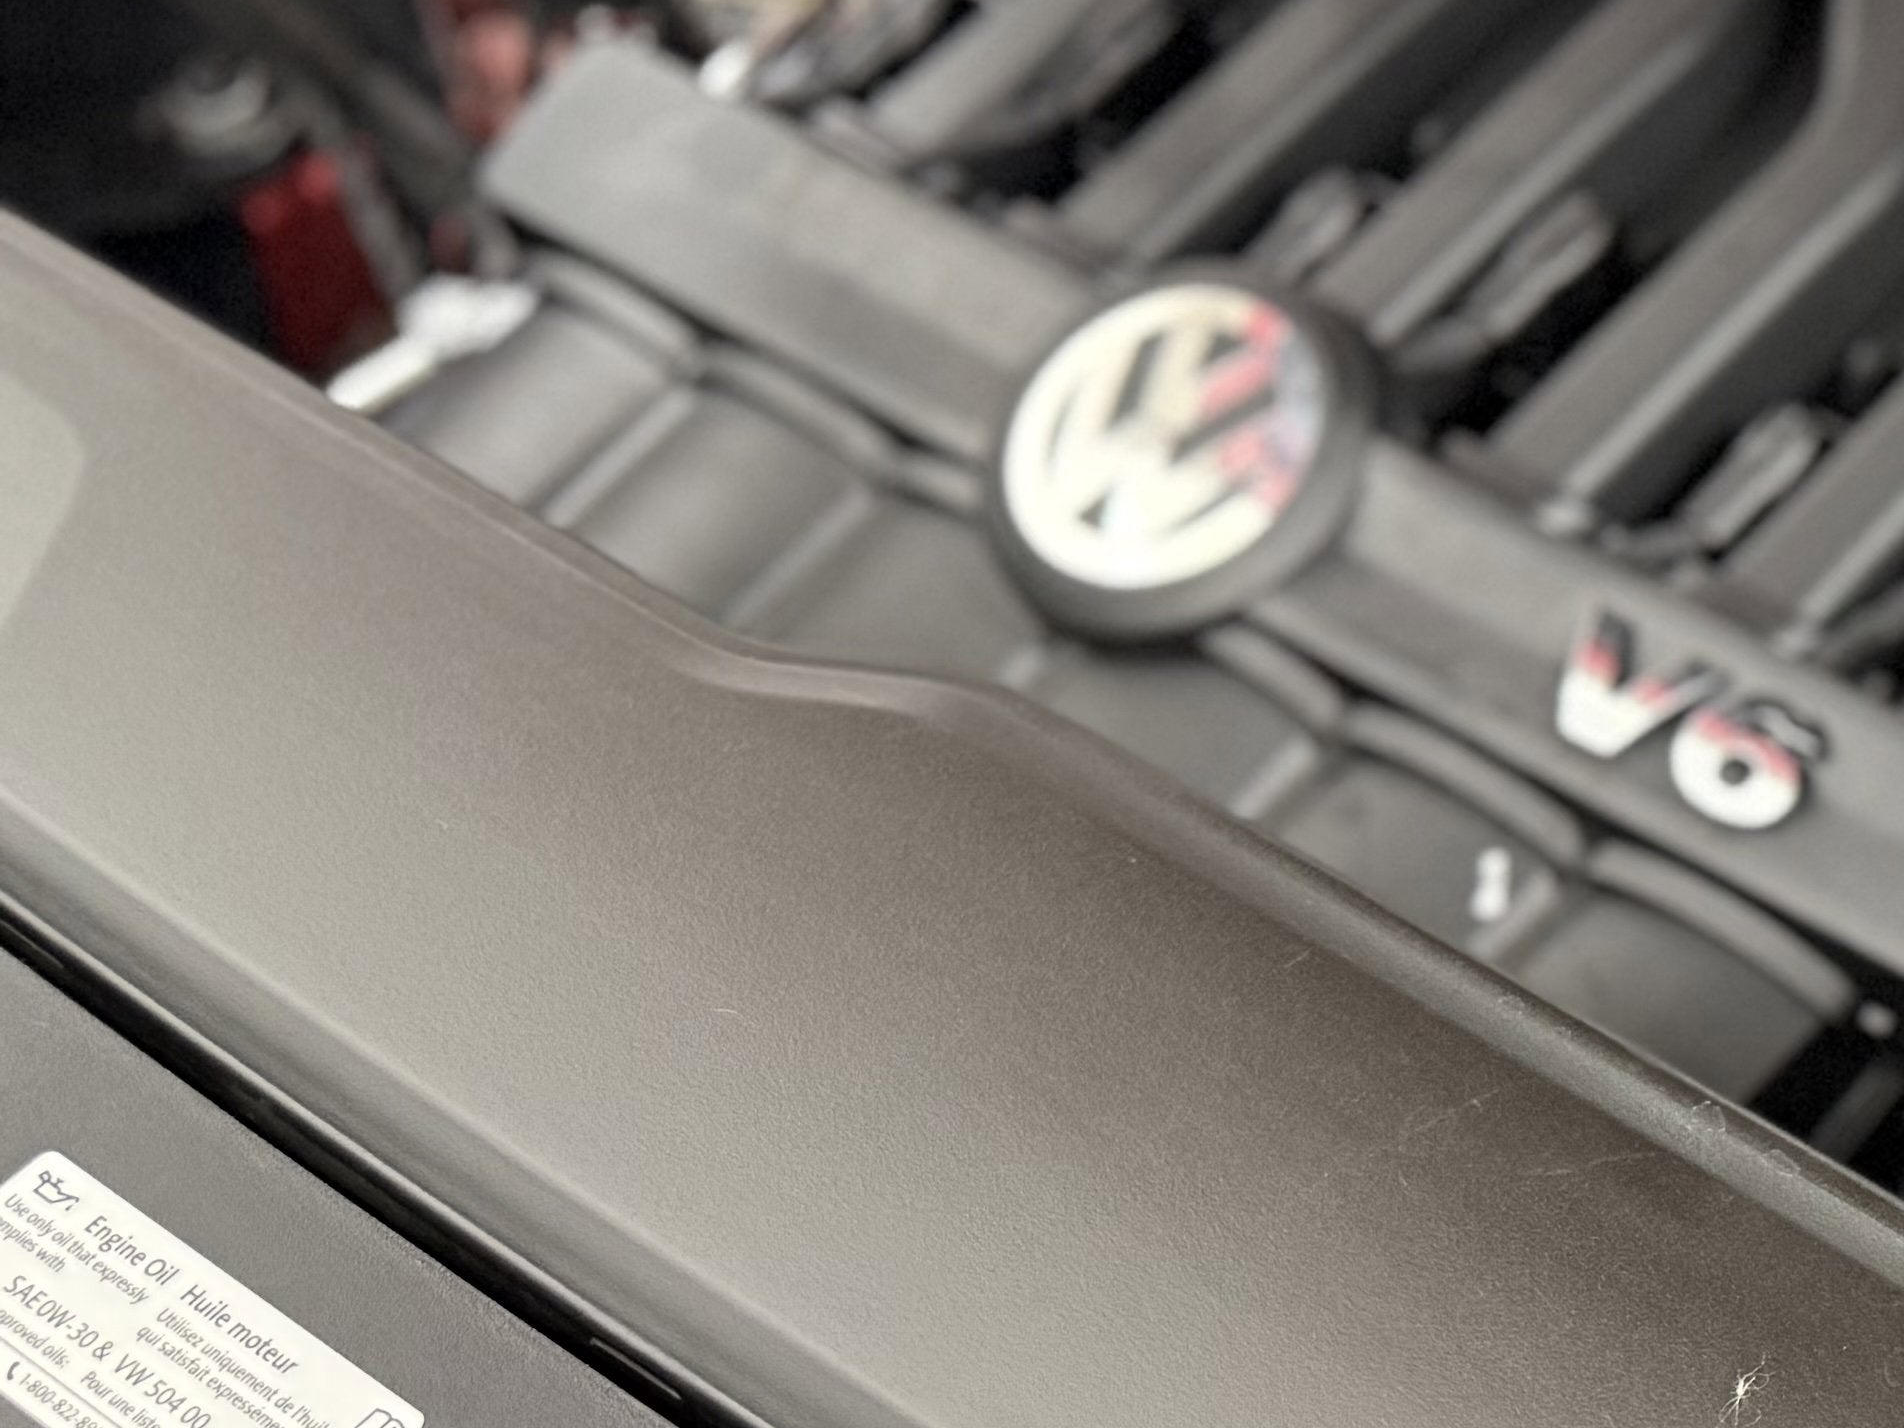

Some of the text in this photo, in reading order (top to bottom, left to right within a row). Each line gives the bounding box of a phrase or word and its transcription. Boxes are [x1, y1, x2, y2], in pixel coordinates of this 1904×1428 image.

[1556, 607, 1830, 830] V6
[0, 1219, 66, 1273] mplies with
[3, 1192, 150, 1305] Use only oil that expressly
[83, 1214, 180, 1286] Engine Oil
[40, 1344, 70, 1369] oils:
[134, 1325, 166, 1347] qui
[156, 1340, 211, 1382] satisfait
[155, 1306, 205, 1348] Utilisez
[199, 1342, 280, 1403] uniquement
[272, 1395, 295, 1415] de
[178, 1283, 299, 1374] Huile moteur
[78, 1369, 114, 1399] Pour
[106, 1393, 136, 1417] une
[90, 1339, 114, 1362] &
[113, 1352, 155, 1387] VW
[142, 1378, 188, 1414] 504
